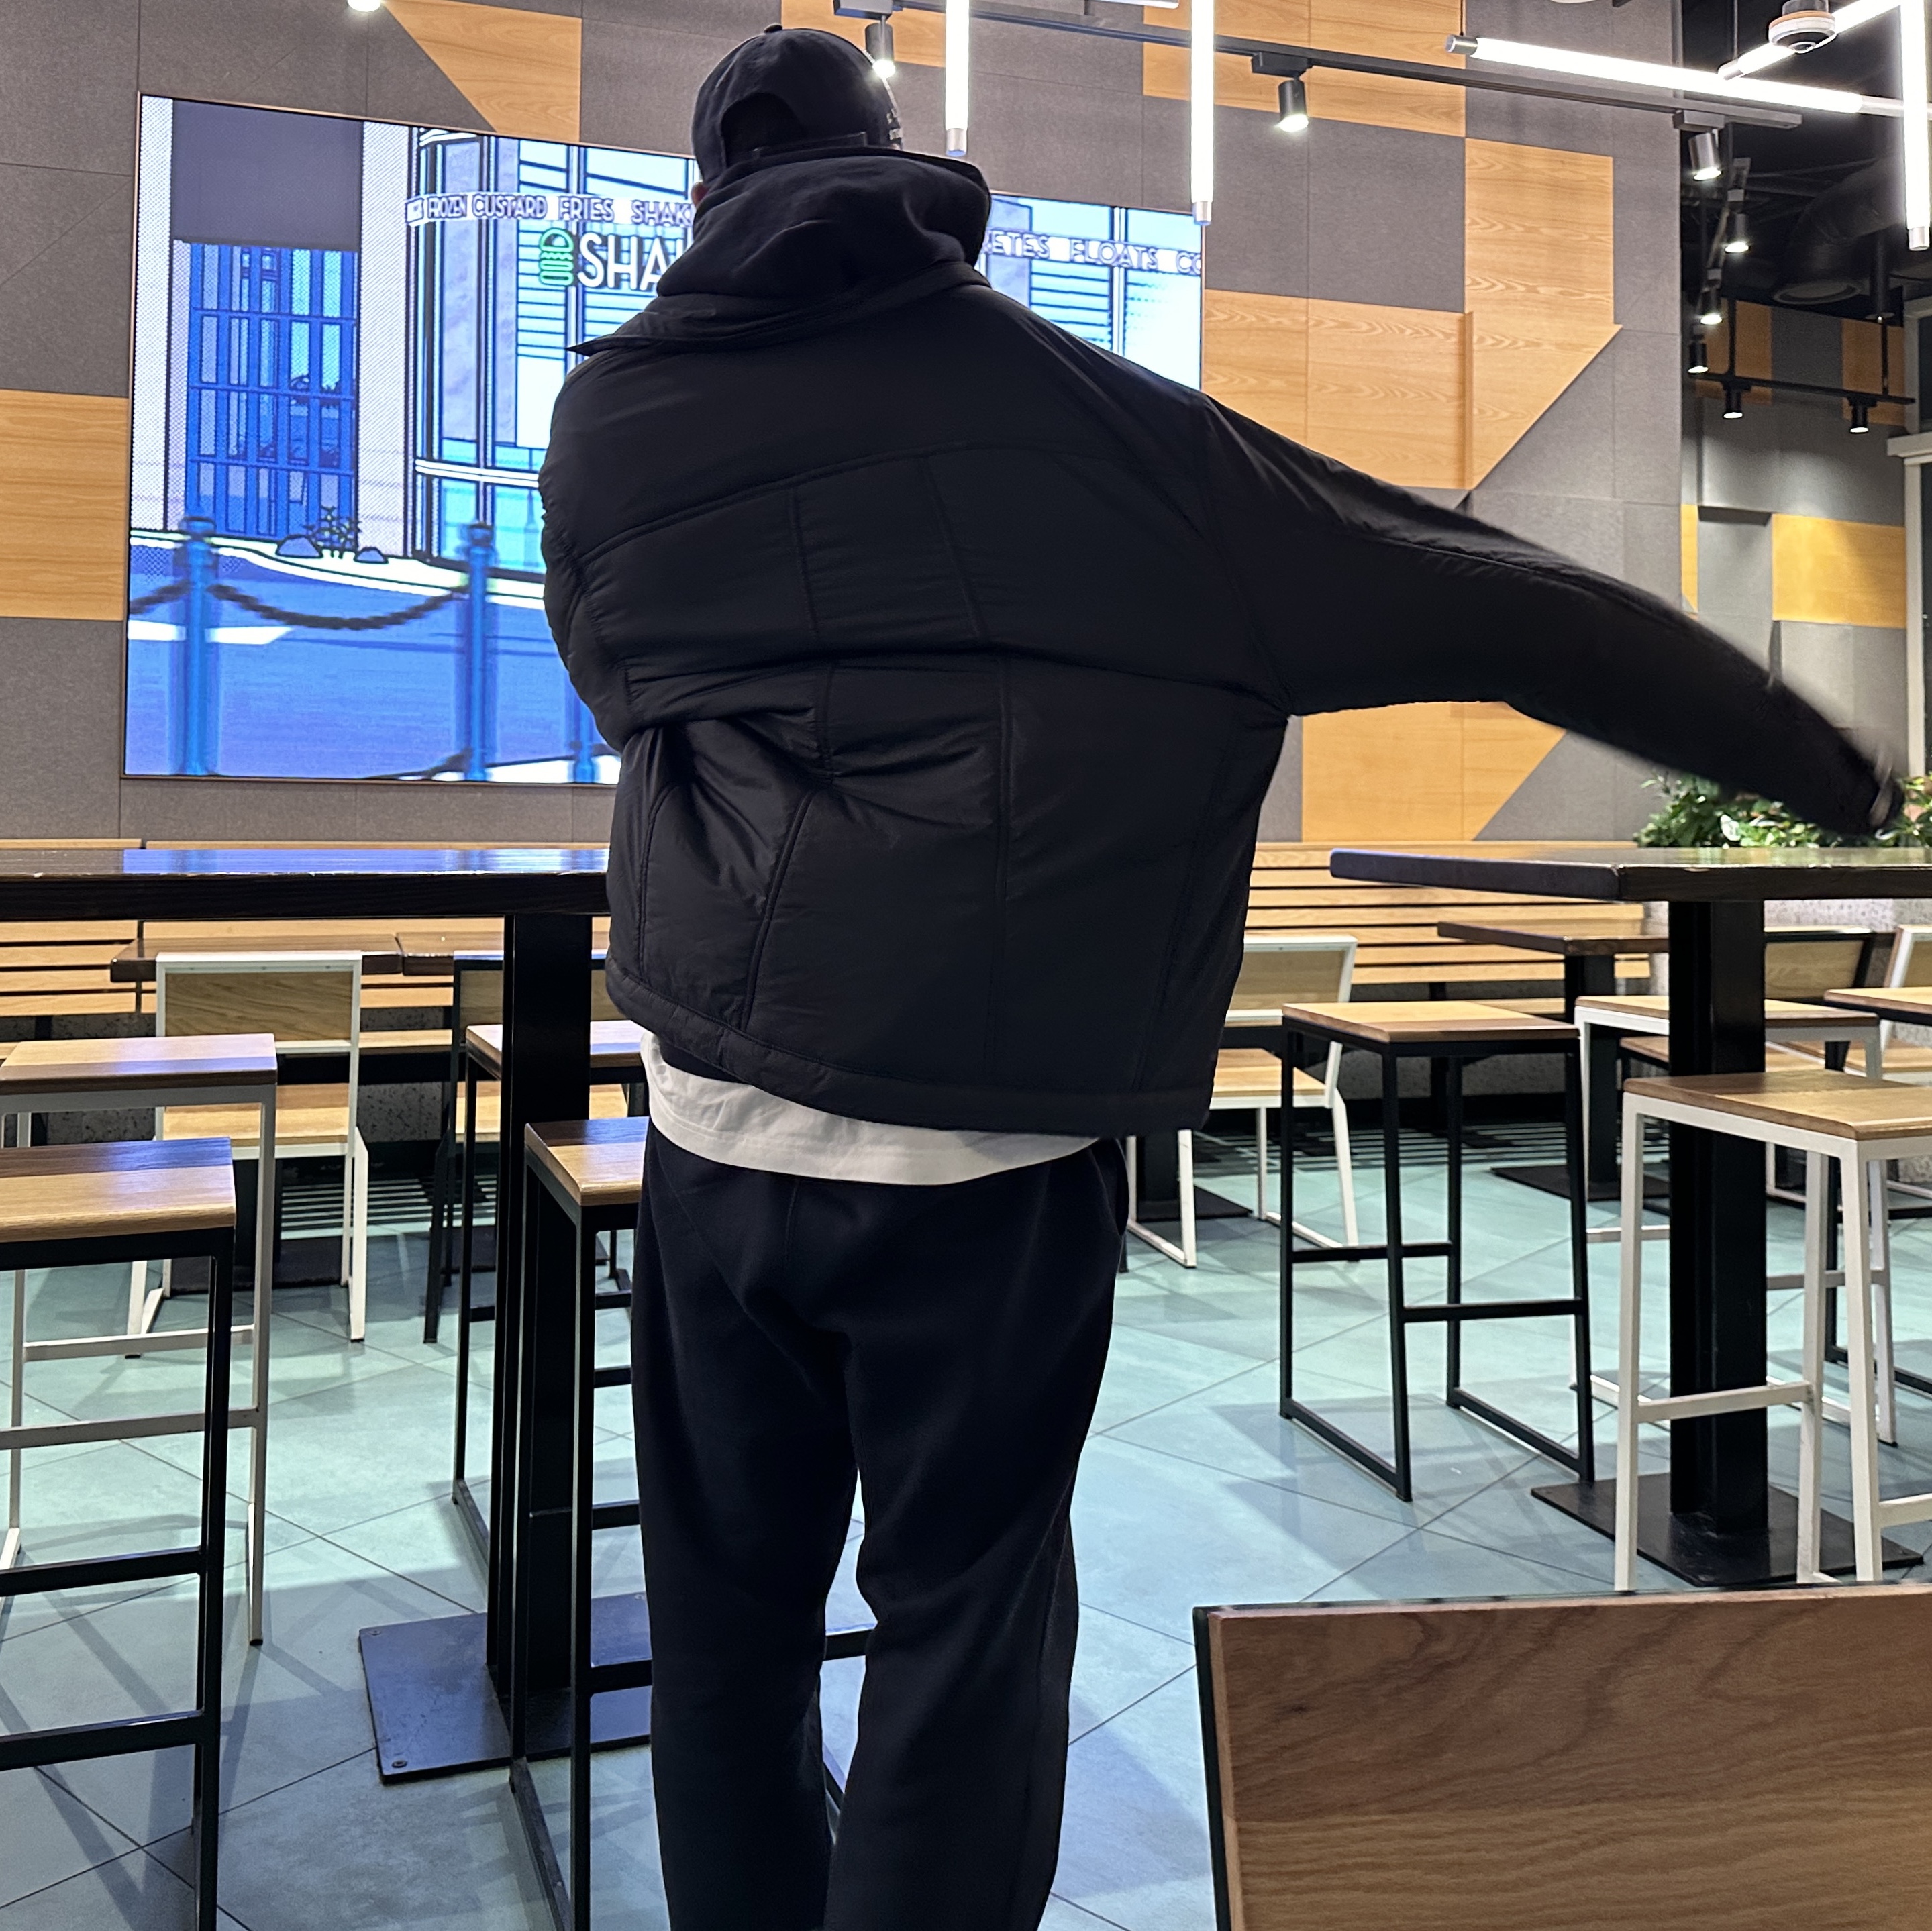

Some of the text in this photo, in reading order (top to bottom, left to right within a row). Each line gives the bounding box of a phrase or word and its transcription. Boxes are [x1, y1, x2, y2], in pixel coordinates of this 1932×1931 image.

[472, 193, 548, 219] CUSTARD
[558, 196, 615, 222] FRIES
[631, 200, 694, 227] SHAK
[1069, 238, 1158, 271] FLOATS
